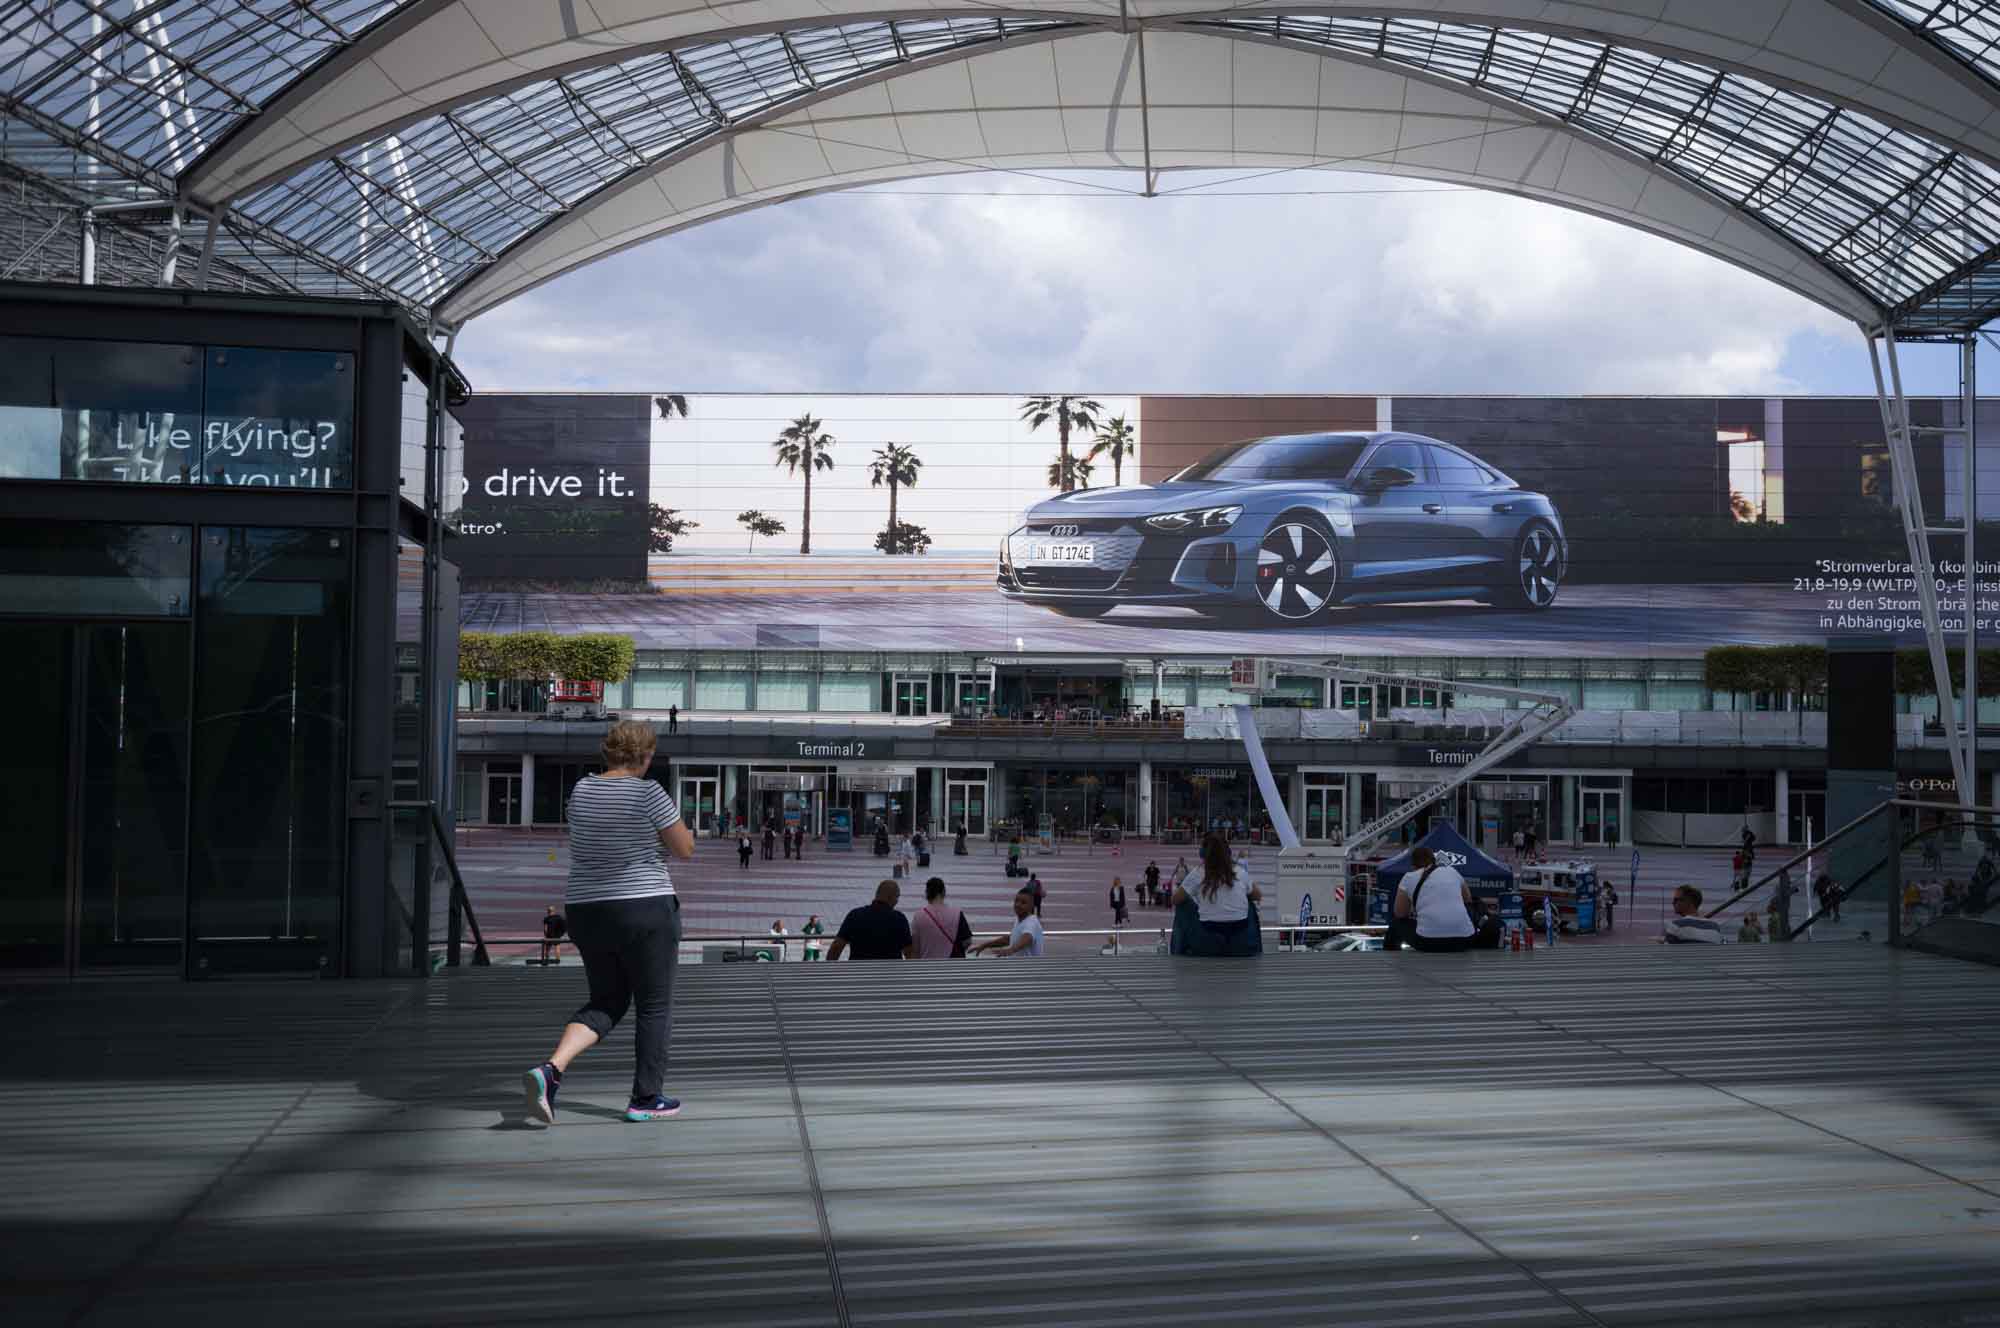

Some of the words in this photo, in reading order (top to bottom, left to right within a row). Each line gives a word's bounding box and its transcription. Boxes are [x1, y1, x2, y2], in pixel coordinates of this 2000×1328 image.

[116, 419, 192, 450] Lke
[205, 420, 337, 458] flying?
[484, 467, 583, 497] drive
[598, 467, 635, 497] it.
[1052, 545, 1063, 560] GT
[1066, 545, 1091, 560] 174E
[1827, 599, 1842, 609] zu
[1847, 595, 1874, 610] den
[1819, 615, 1833, 629] in
[1973, 615, 1991, 630] er
[796, 741, 854, 757] Terminal
[856, 742, 865, 756] 2
